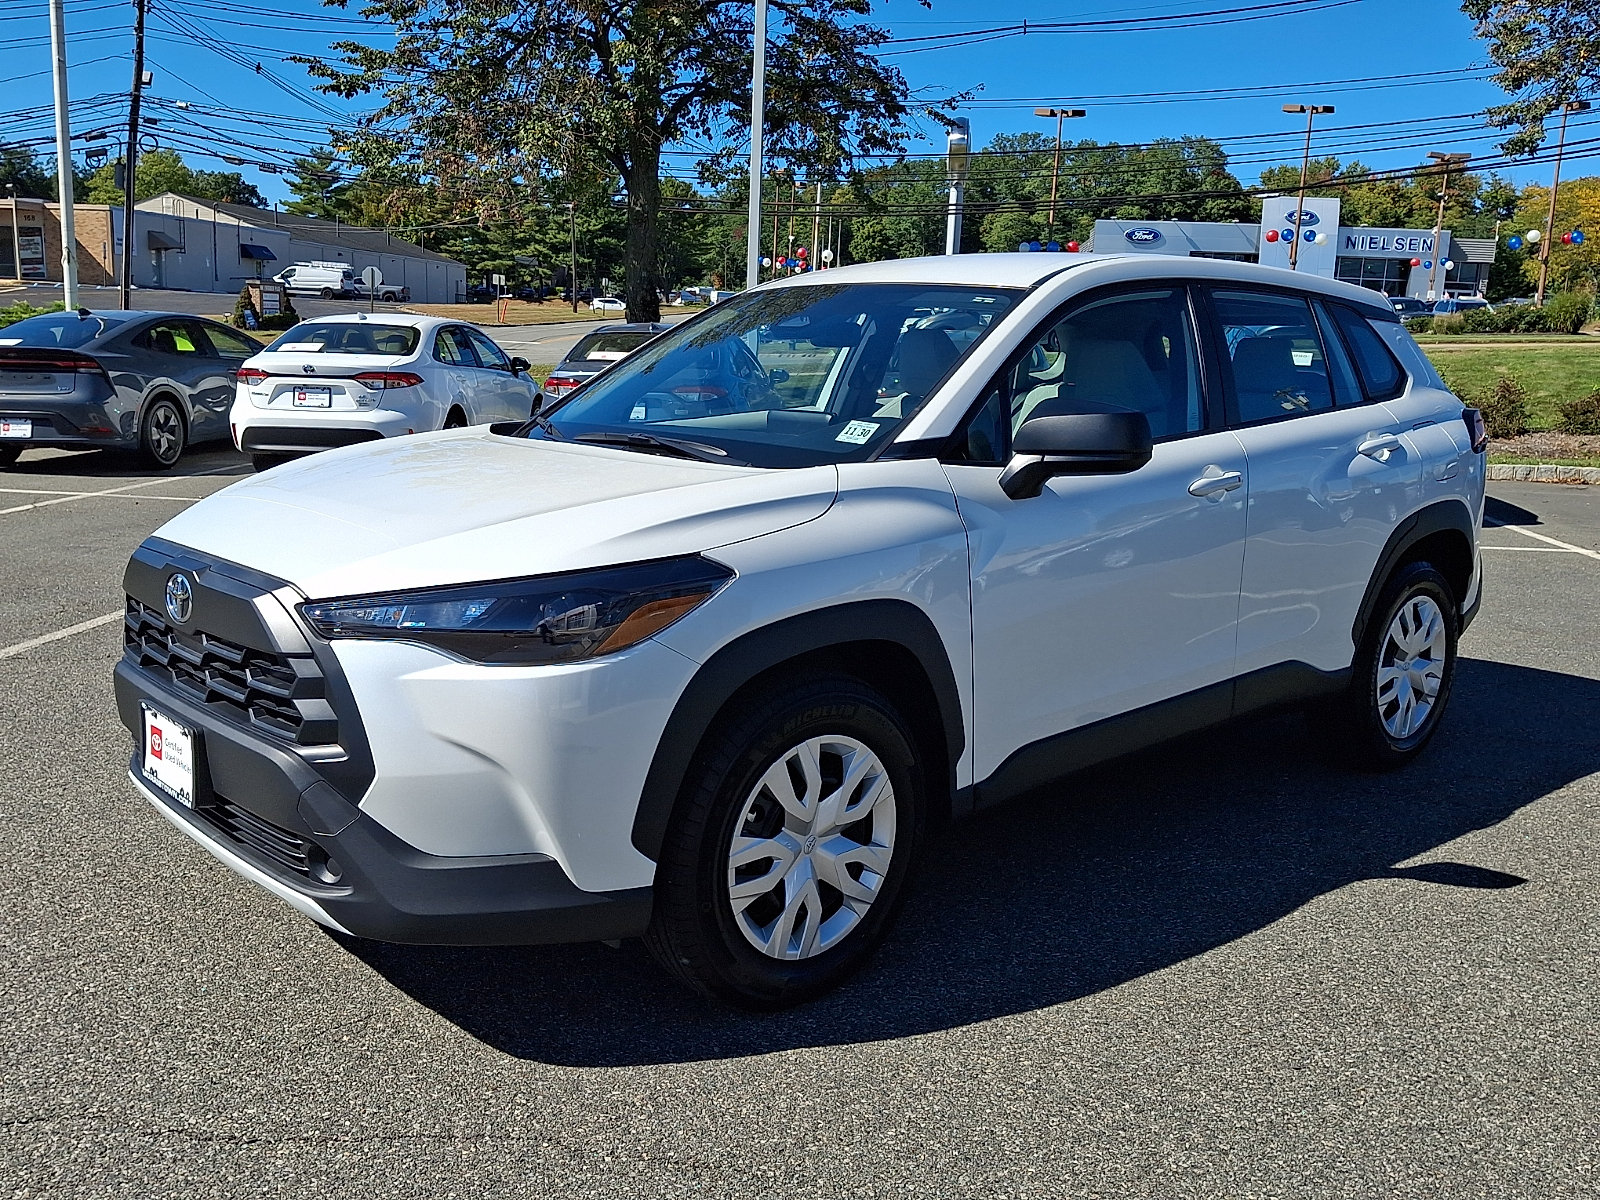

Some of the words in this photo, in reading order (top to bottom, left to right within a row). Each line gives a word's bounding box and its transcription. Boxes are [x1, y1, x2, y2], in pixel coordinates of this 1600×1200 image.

[1132, 230, 1155, 241] Ford
[1345, 235, 1435, 252] NIELSEN
[844, 427, 858, 435] 11
[858, 429, 871, 437] 30
[783, 704, 857, 733] MICHELIN
[164, 737, 183, 756] Certified
[164, 750, 176, 764] Used
